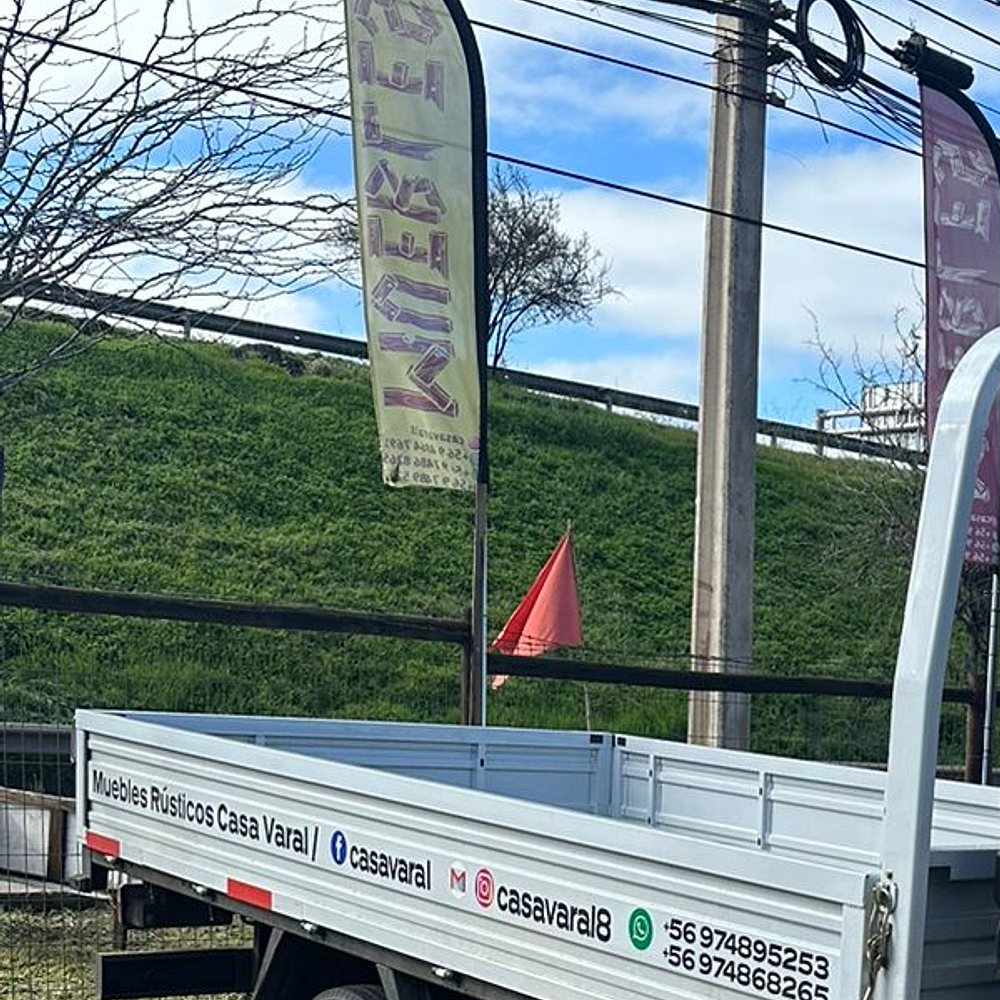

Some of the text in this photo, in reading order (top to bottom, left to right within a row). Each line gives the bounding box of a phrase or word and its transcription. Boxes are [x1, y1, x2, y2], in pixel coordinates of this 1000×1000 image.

[92, 769, 148, 809] Muebles
[150, 784, 215, 828] Rústicos
[217, 803, 260, 840] Casa
[262, 815, 309, 855] Varal
[349, 844, 431, 890] casavaral
[496, 885, 612, 943] casavaral8
[662, 945, 696, 971] +56
[663, 918, 830, 980] +56 974895253
